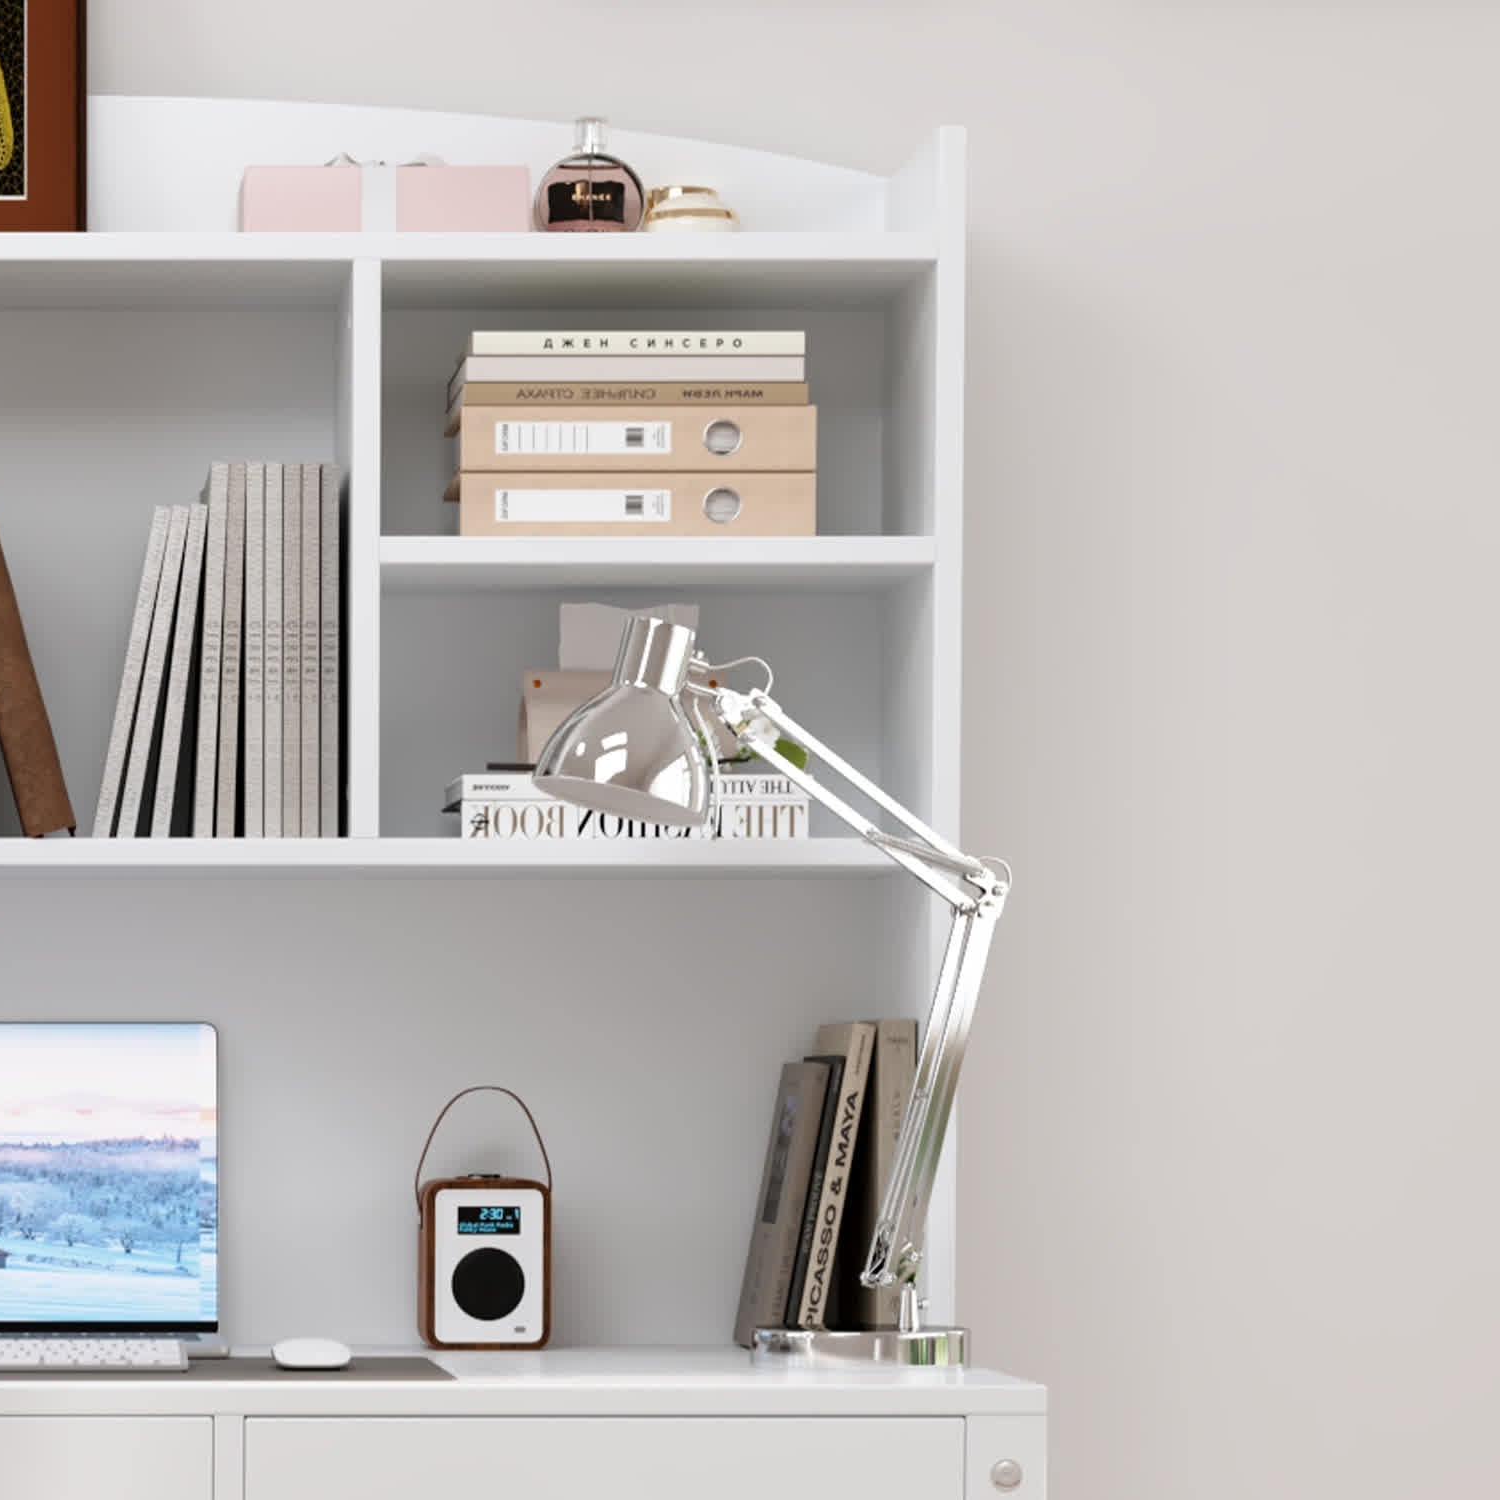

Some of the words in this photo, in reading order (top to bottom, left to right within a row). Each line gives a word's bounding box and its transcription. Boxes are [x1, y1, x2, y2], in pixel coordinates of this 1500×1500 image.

[543, 338, 609, 350] ДЖЕН
[629, 338, 743, 349] СИНСЕРО
[760, 780, 792, 794] THE
[836, 1091, 859, 1168] MAYA
[832, 1177, 842, 1196] &
[805, 1204, 837, 1330] PICASSO
